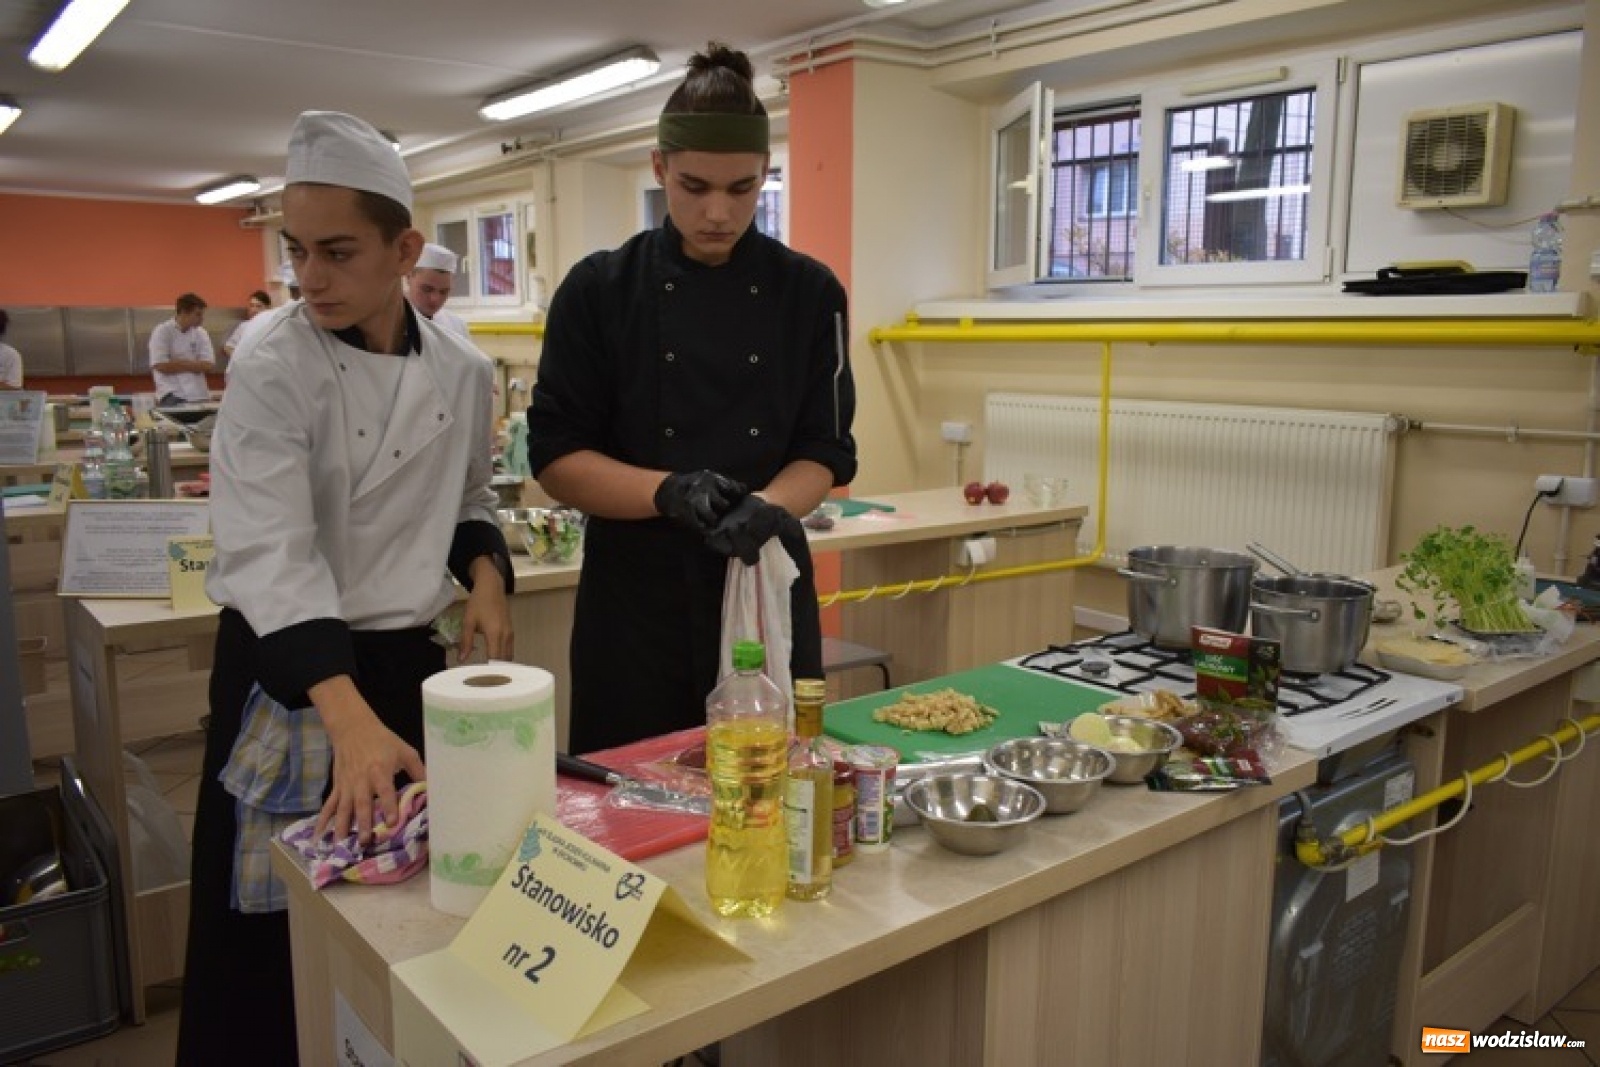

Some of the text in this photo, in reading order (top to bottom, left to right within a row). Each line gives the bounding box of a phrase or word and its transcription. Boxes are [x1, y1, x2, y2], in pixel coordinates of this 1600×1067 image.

[511, 863, 620, 949] Stanowisko
[502, 942, 556, 985] nr 2
